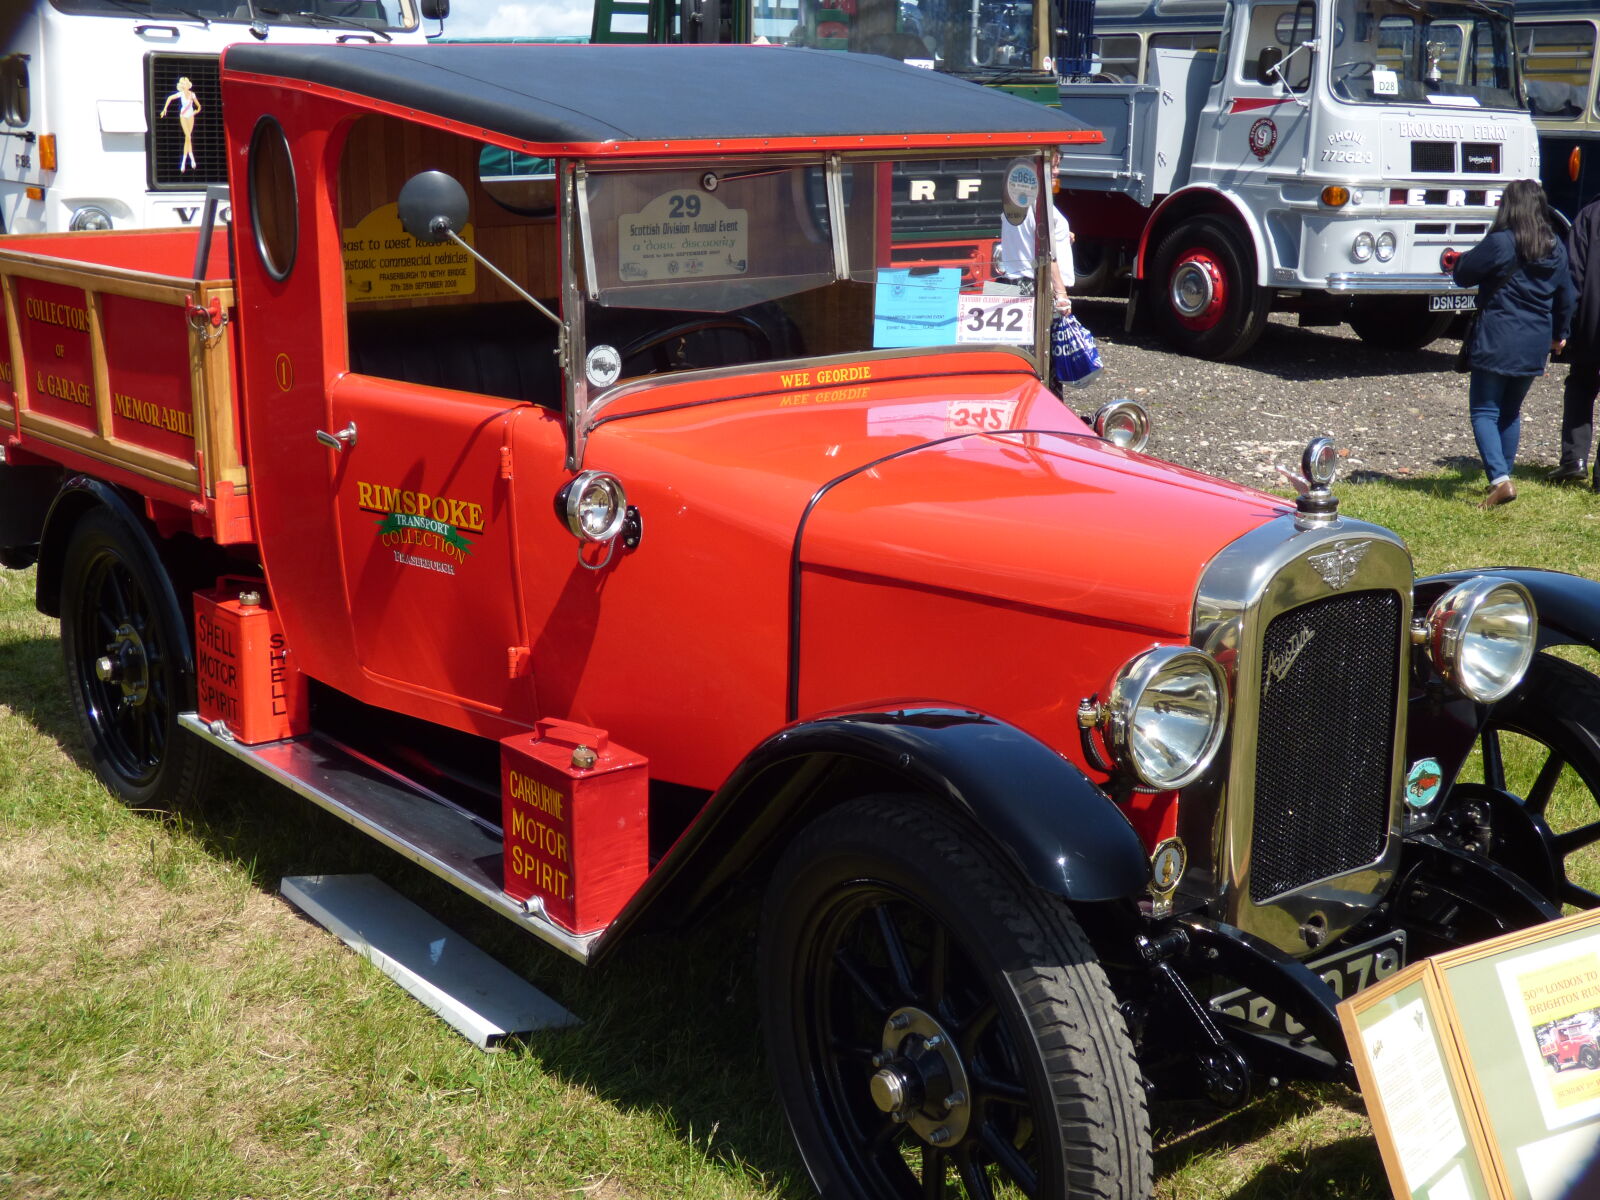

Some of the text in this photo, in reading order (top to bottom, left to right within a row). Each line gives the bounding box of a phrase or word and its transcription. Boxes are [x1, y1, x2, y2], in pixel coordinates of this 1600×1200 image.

[1379, 81, 1396, 91] D28
[1328, 129, 1366, 146] PHONE
[1399, 122, 1508, 140] BROUGHTY FERRY
[668, 194, 701, 218] 29
[630, 219, 738, 236] Scottish Division Annual Event
[368, 239, 380, 250] to
[385, 237, 412, 249] west
[380, 253, 432, 268] commercial
[434, 251, 468, 265] vehicles
[447, 268, 467, 277] BRIDGE
[26, 297, 92, 333] COLLECTORS
[1433, 296, 1454, 309] DSN
[967, 307, 1024, 332] 342
[55, 344, 65, 357] OF
[780, 366, 872, 388] WEE GEORDIE
[37, 370, 45, 393] &
[47, 374, 92, 407] GARAGE
[114, 392, 195, 437] MEMORABILI
[357, 481, 485, 531] RIMSPOKE
[395, 513, 450, 535] TRANSPORT
[382, 528, 466, 565] COLLECTION
[200, 615, 236, 659] SHELL
[200, 652, 238, 690] MOTOR
[269, 633, 287, 717] SHELL
[201, 679, 238, 721] SPIRIT
[509, 770, 565, 822] CARBURINE
[512, 807, 568, 863] MOTOR
[512, 845, 569, 900] SPIRIT
[1544, 975, 1584, 995] LONDON
[1584, 969, 1598, 983] TO
[1529, 985, 1600, 1016] BRIGHTON RUN
